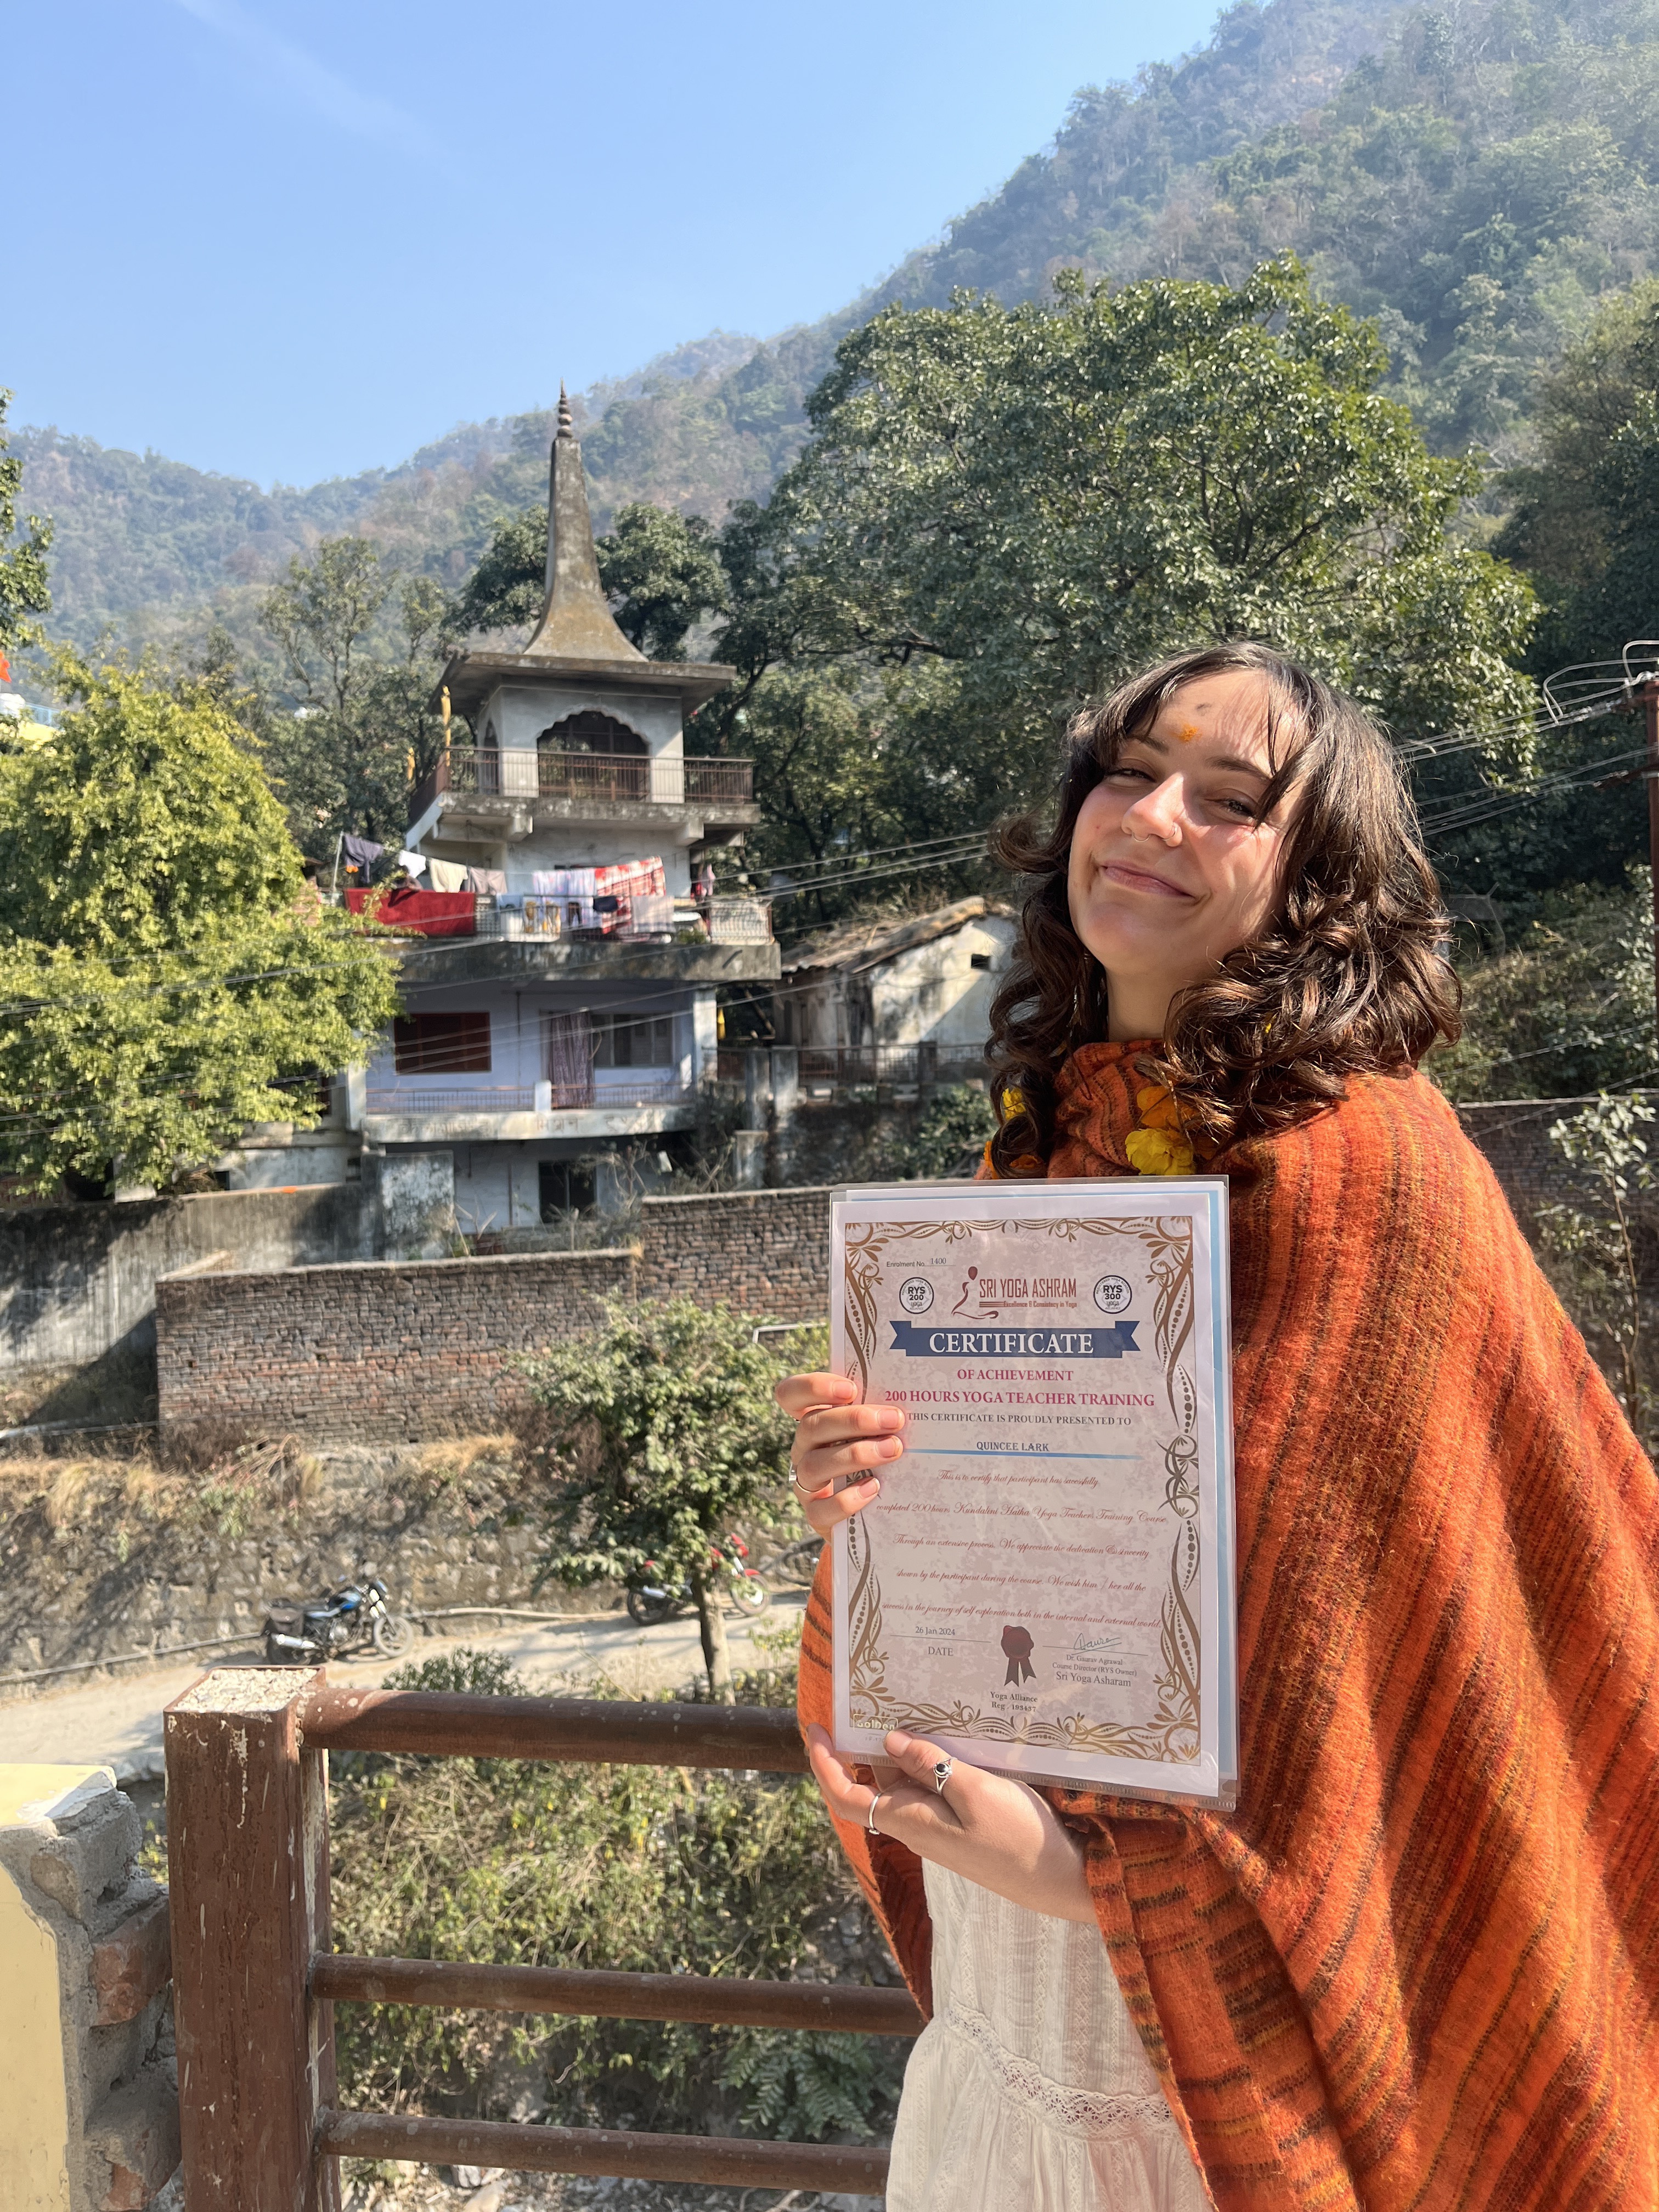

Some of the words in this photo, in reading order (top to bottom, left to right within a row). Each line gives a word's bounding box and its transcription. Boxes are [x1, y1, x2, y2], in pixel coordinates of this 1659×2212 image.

[908, 1286, 926, 1294] RYS
[979, 1278, 996, 1298] SRI
[1000, 1278, 1029, 1298] YOGA
[1032, 1278, 1076, 1298] ASHRAM
[1103, 1285, 1123, 1293] RYS
[1065, 1300, 1077, 1308] Yoga
[929, 1332, 1094, 1354] CERTIFICATE
[957, 1369, 975, 1380] OF
[977, 1369, 1074, 1381] ACHIEVEMENT
[884, 1390, 907, 1402] 200
[910, 1391, 960, 1402] HOURS
[962, 1391, 1003, 1403] YOGA
[1006, 1392, 1077, 1404] TEACHER
[1078, 1393, 1155, 1406] TRAINING
[906, 1413, 929, 1421] THIS
[931, 1413, 994, 1423] CERTIFICATE
[1008, 1415, 1053, 1424] PROUDLY
[1056, 1416, 1115, 1425] PRESENTED
[1116, 1417, 1131, 1425] TO
[977, 1441, 1019, 1451] QUINCEE
[1021, 1442, 1050, 1452] LARK
[936, 1469, 954, 1480] This
[970, 1472, 992, 1486] certify
[993, 1474, 1008, 1482] that
[1007, 1475, 1048, 1487] participant
[1049, 1475, 1062, 1485] has
[876, 1503, 911, 1514] completed
[911, 1503, 931, 1513] 200
[930, 1504, 950, 1513] hours
[953, 1502, 998, 1515] Kundalini
[1000, 1503, 1030, 1516] Hatha
[1031, 1505, 1058, 1521] Yoga
[1096, 1509, 1133, 1526] Training
[1136, 1510, 1166, 1522] Course
[892, 1533, 924, 1549] Through
[937, 1539, 969, 1547] extensive
[967, 1540, 996, 1551] process.
[999, 1537, 1020, 1550] We
[1017, 1542, 1053, 1554] appreciate
[1053, 1543, 1065, 1552] the
[1066, 1544, 1104, 1554] dedication
[1118, 1548, 1150, 1560] sincerity
[896, 1568, 918, 1578] shown
[919, 1570, 929, 1582] by
[929, 1570, 940, 1579] the
[939, 1572, 980, 1584] participant
[980, 1573, 1007, 1587] during
[1007, 1573, 1019, 1583] the
[1047, 1574, 1070, 1587] We
[1065, 1578, 1081, 1587] wish
[1082, 1578, 1098, 1588] him
[1108, 1581, 1122, 1590] her
[1122, 1582, 1135, 1590] all
[1134, 1582, 1147, 1592] the
[915, 1602, 926, 1611] the
[922, 1605, 954, 1617] journey
[955, 1604, 964, 1617] of
[962, 1605, 977, 1617] self
[975, 1607, 1015, 1618] exploration
[1017, 1609, 1032, 1618] both
[1033, 1611, 1042, 1619] in
[1042, 1610, 1054, 1620] the
[1055, 1613, 1088, 1622] internal
[1087, 1615, 1105, 1623] and
[1104, 1617, 1137, 1627] external
[1137, 1618, 1161, 1628] world.
[915, 1626, 924, 1634] 26
[925, 1626, 937, 1635] Jan
[939, 1627, 956, 1636] 2024
[928, 1646, 954, 1657] DATE
[1099, 1657, 1124, 1666] Agrawal
[1074, 1663, 1098, 1672] Director
[1098, 1666, 1114, 1674] (RYS
[1115, 1668, 1137, 1677] Owner)
[1056, 1671, 1069, 1681] Sri
[1070, 1672, 1092, 1685] Yoga
[1093, 1675, 1132, 1687] Asharam
[990, 1691, 1008, 1701] Yoga
[1009, 1693, 1039, 1702] Alliance
[1011, 1703, 1037, 1712] 193437
